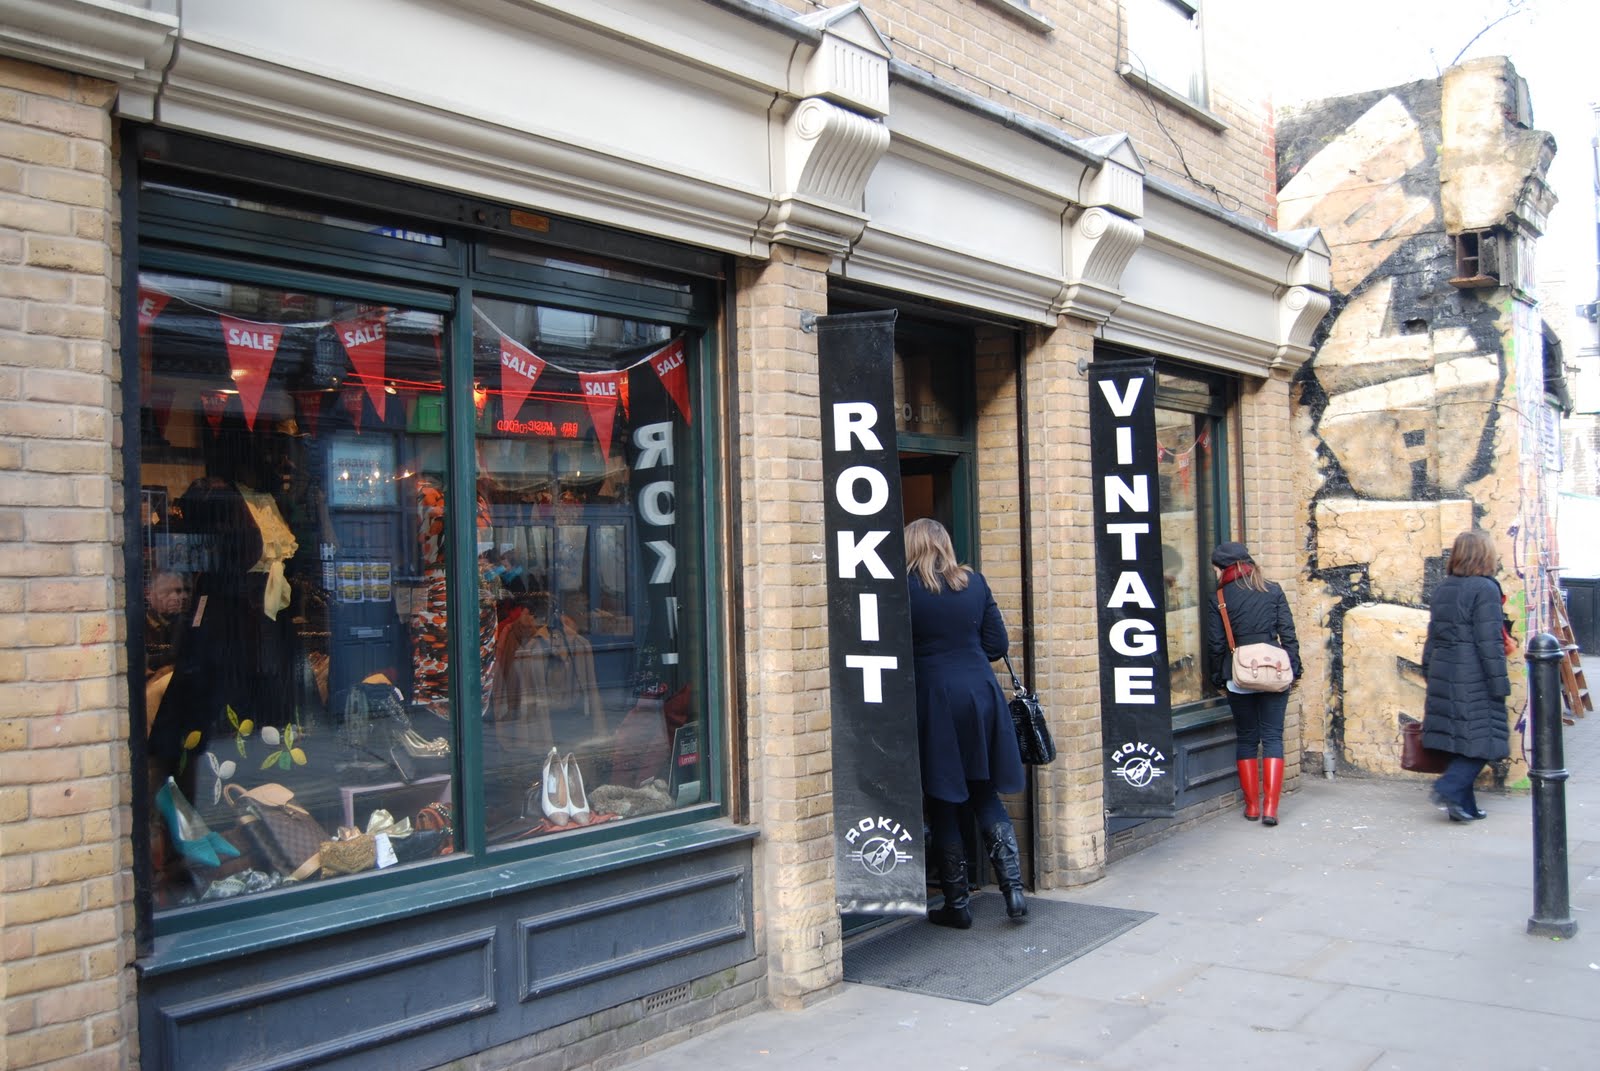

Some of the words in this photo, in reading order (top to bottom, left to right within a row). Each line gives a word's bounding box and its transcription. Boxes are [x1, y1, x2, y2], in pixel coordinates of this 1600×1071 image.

[228, 328, 274, 351] SALE
[343, 323, 384, 348] SALE
[501, 351, 537, 380] SALE
[656, 350, 685, 377] SALE
[585, 381, 617, 396] SALE
[832, 401, 898, 704] ROKIT
[1098, 377, 1158, 706] VINTAGE
[1111, 741, 1165, 763] ROKIT
[845, 816, 913, 844] ROKIT
